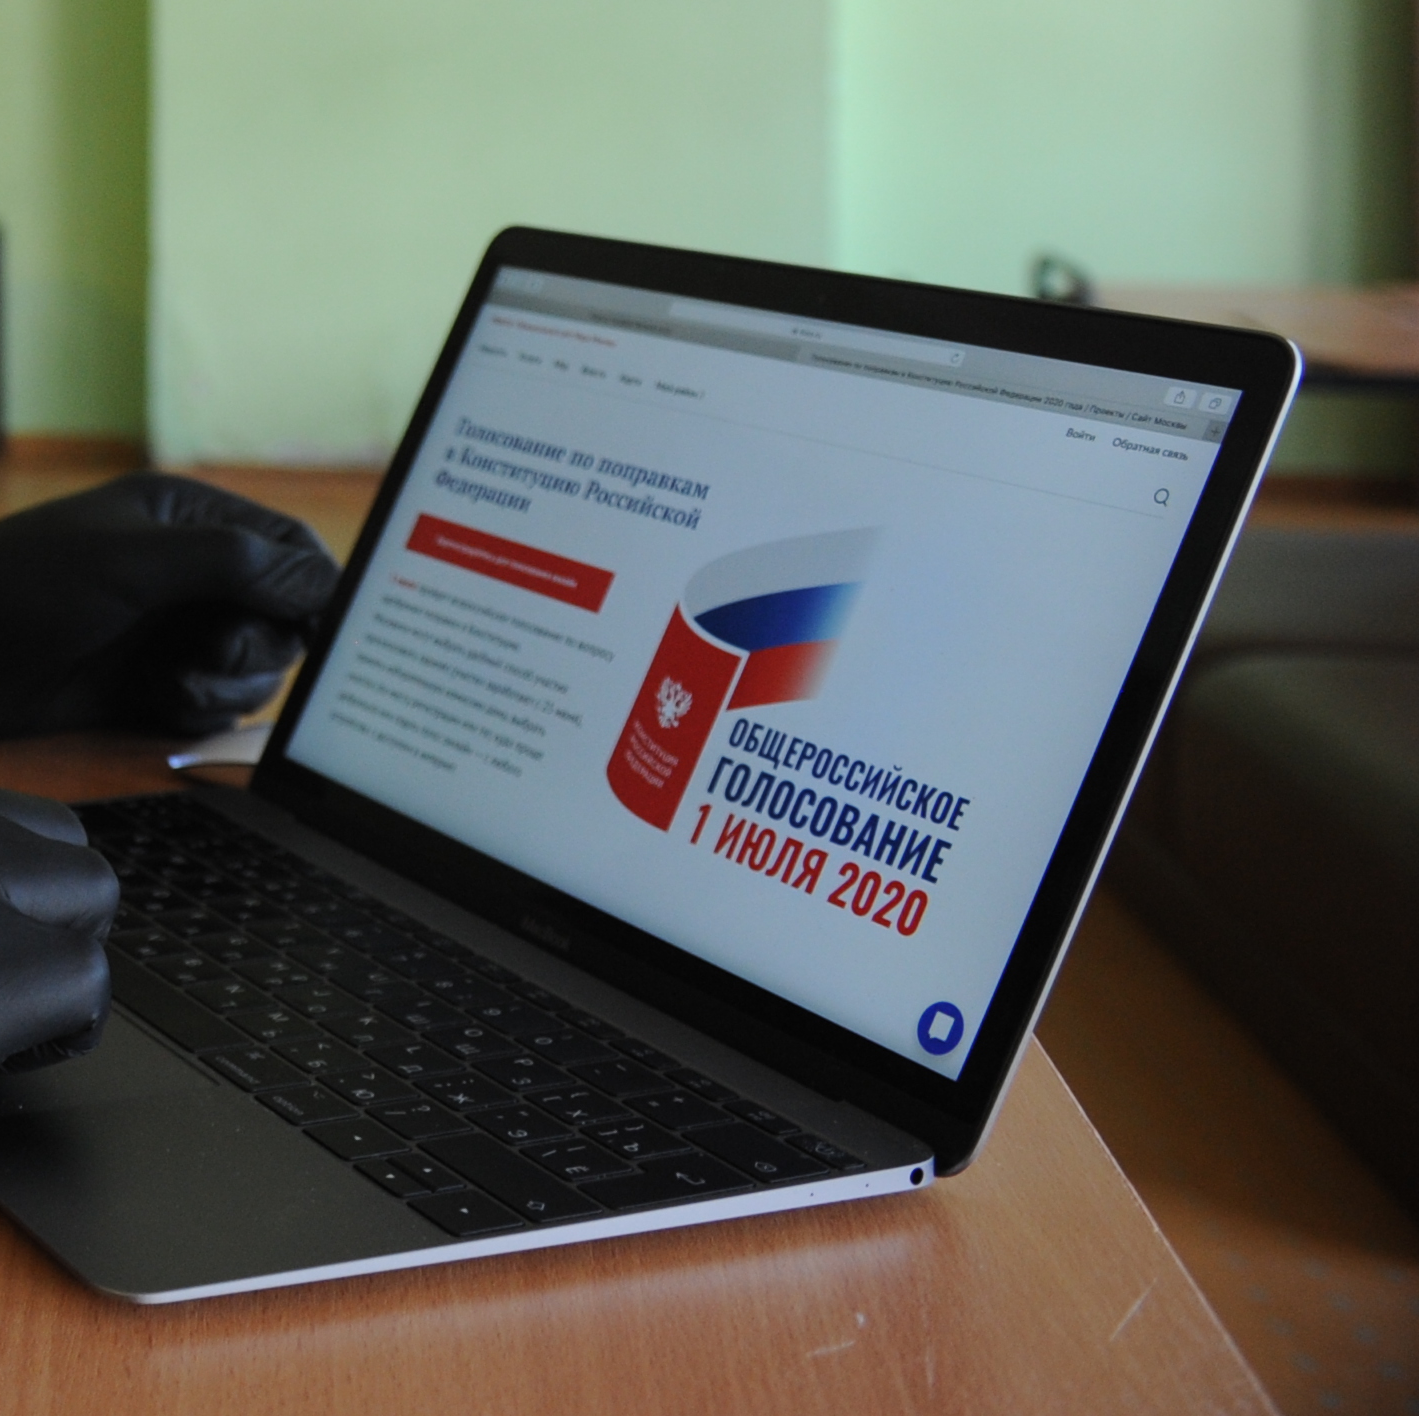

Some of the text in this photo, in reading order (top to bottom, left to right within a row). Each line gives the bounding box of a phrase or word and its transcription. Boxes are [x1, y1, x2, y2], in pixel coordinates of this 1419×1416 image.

[1042, 396, 1065, 408] 2020
[1130, 412, 1154, 424] Сайт
[1152, 416, 1189, 431] Москвы
[1064, 427, 1098, 443] Войти
[1109, 436, 1190, 462] Обратная связь
[434, 468, 535, 519] Федерации
[454, 417, 713, 506] Голосование по поправкам
[455, 445, 586, 502] Конституцию
[581, 478, 705, 532] Российской
[729, 718, 970, 832] ОБЩЕРОССИЙСКОЕ
[707, 756, 952, 884] ГОЛОСОВАНИЕ
[690, 804, 929, 937] 1 ИЮЛЯ 2020
